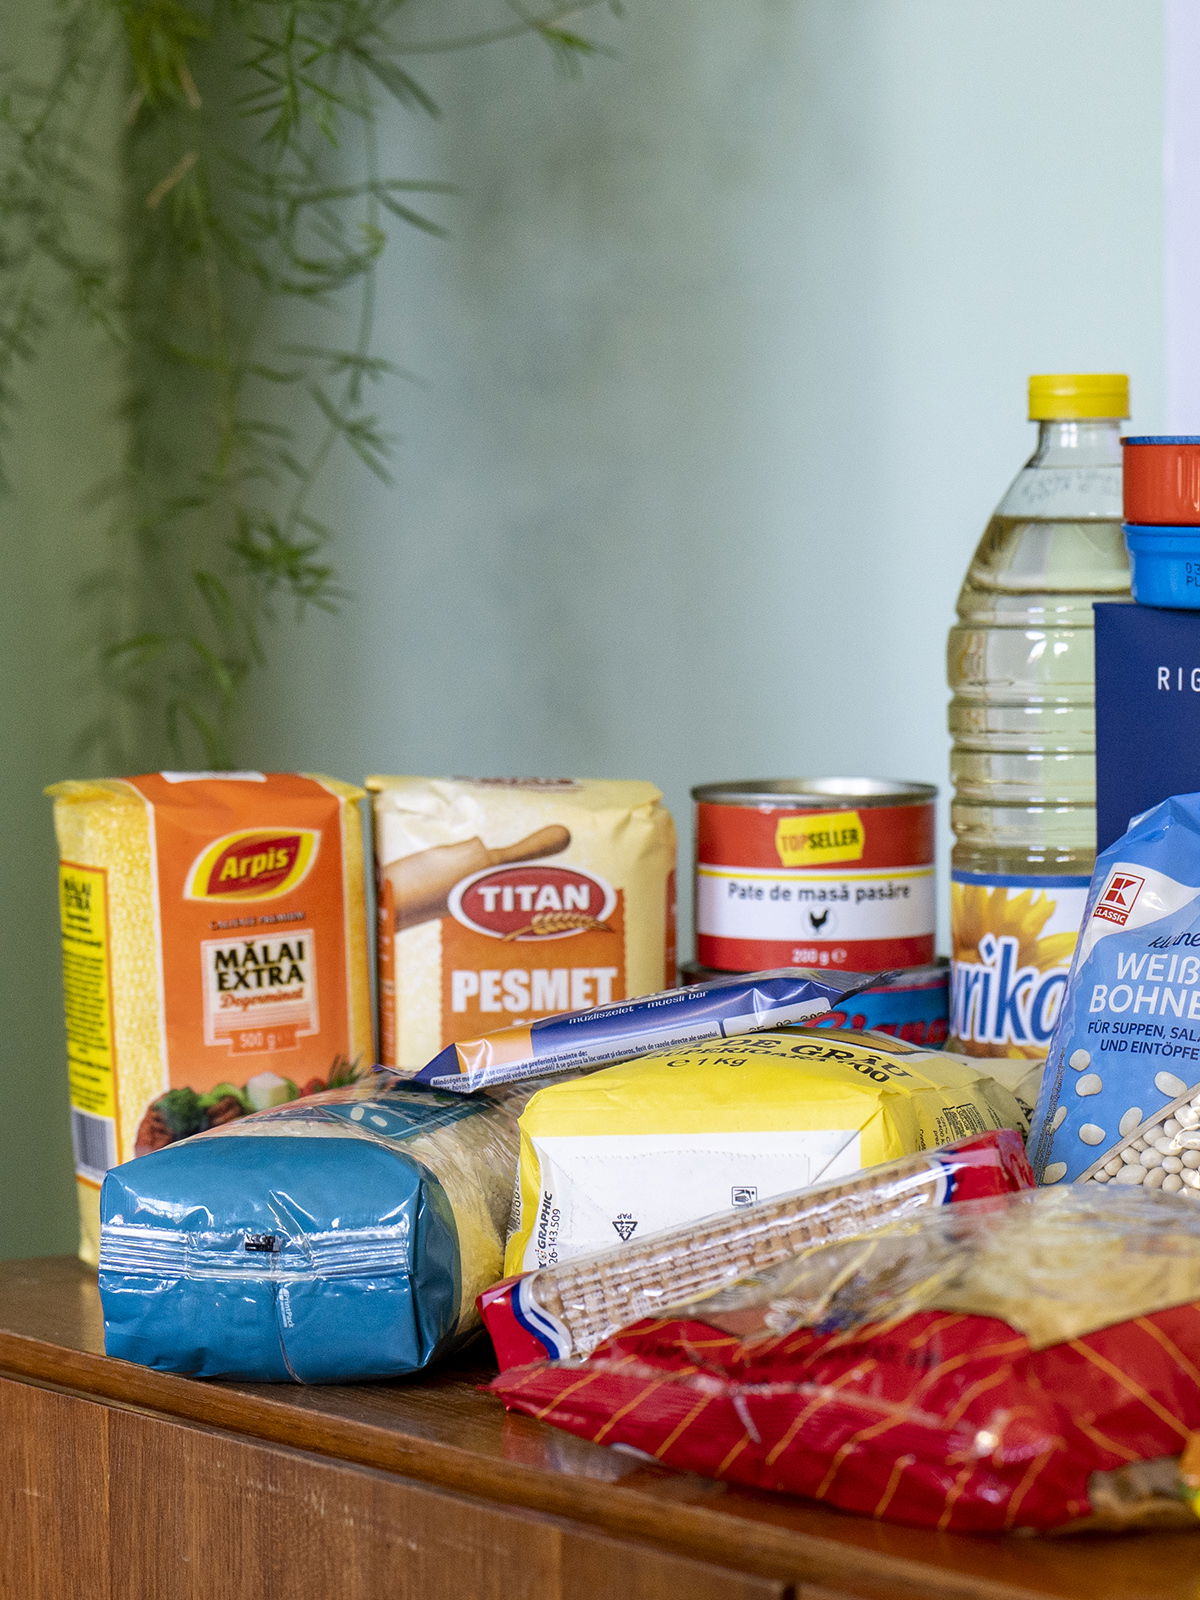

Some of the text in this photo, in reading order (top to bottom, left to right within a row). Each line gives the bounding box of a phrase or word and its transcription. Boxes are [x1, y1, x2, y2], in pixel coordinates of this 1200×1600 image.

[219, 846, 290, 882] Arpis
[478, 884, 591, 912] TITAN
[728, 880, 911, 903] Pate de masă pasăre
[1095, 908, 1126, 923] CLASSIC
[215, 941, 305, 970] MĂLAI
[793, 948, 818, 963] 200
[820, 950, 829, 966] g
[217, 964, 304, 992] EXTRA
[452, 967, 618, 1013] PESMET
[688, 990, 709, 1003] bar
[1088, 1021, 1110, 1035] FÜR
[1112, 1022, 1167, 1040] SUPPEN,
[712, 1057, 748, 1068] Kg
[720, 1038, 913, 1078] DE GRÂU
[1100, 1039, 1200, 1061] UND EINTÖPFE
[537, 1191, 553, 1249] GRAPHIC
